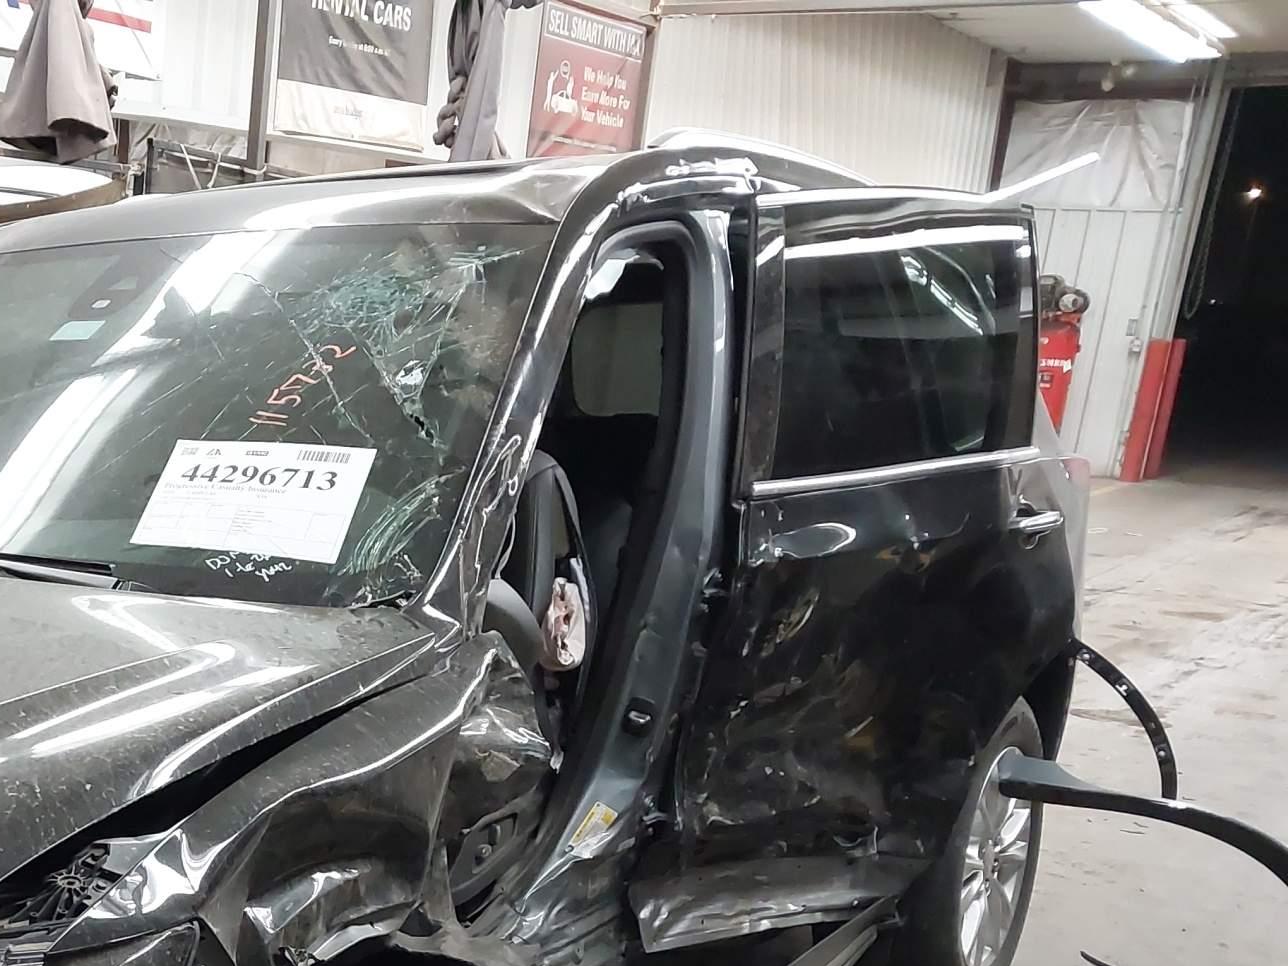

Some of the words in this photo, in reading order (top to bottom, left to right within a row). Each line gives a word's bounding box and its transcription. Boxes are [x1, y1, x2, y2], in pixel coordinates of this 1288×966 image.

[373, 1, 411, 31] CARS
[549, 9, 569, 35] SELL
[571, 16, 603, 45] SMART
[603, 26, 626, 53] WITH
[584, 66, 596, 82] We
[596, 70, 613, 88] Help
[614, 74, 626, 90] You
[599, 90, 618, 108] More
[618, 94, 631, 110] For
[581, 106, 595, 122] Your
[596, 109, 624, 128] Vehicle
[181, 464, 338, 491] 44296713
